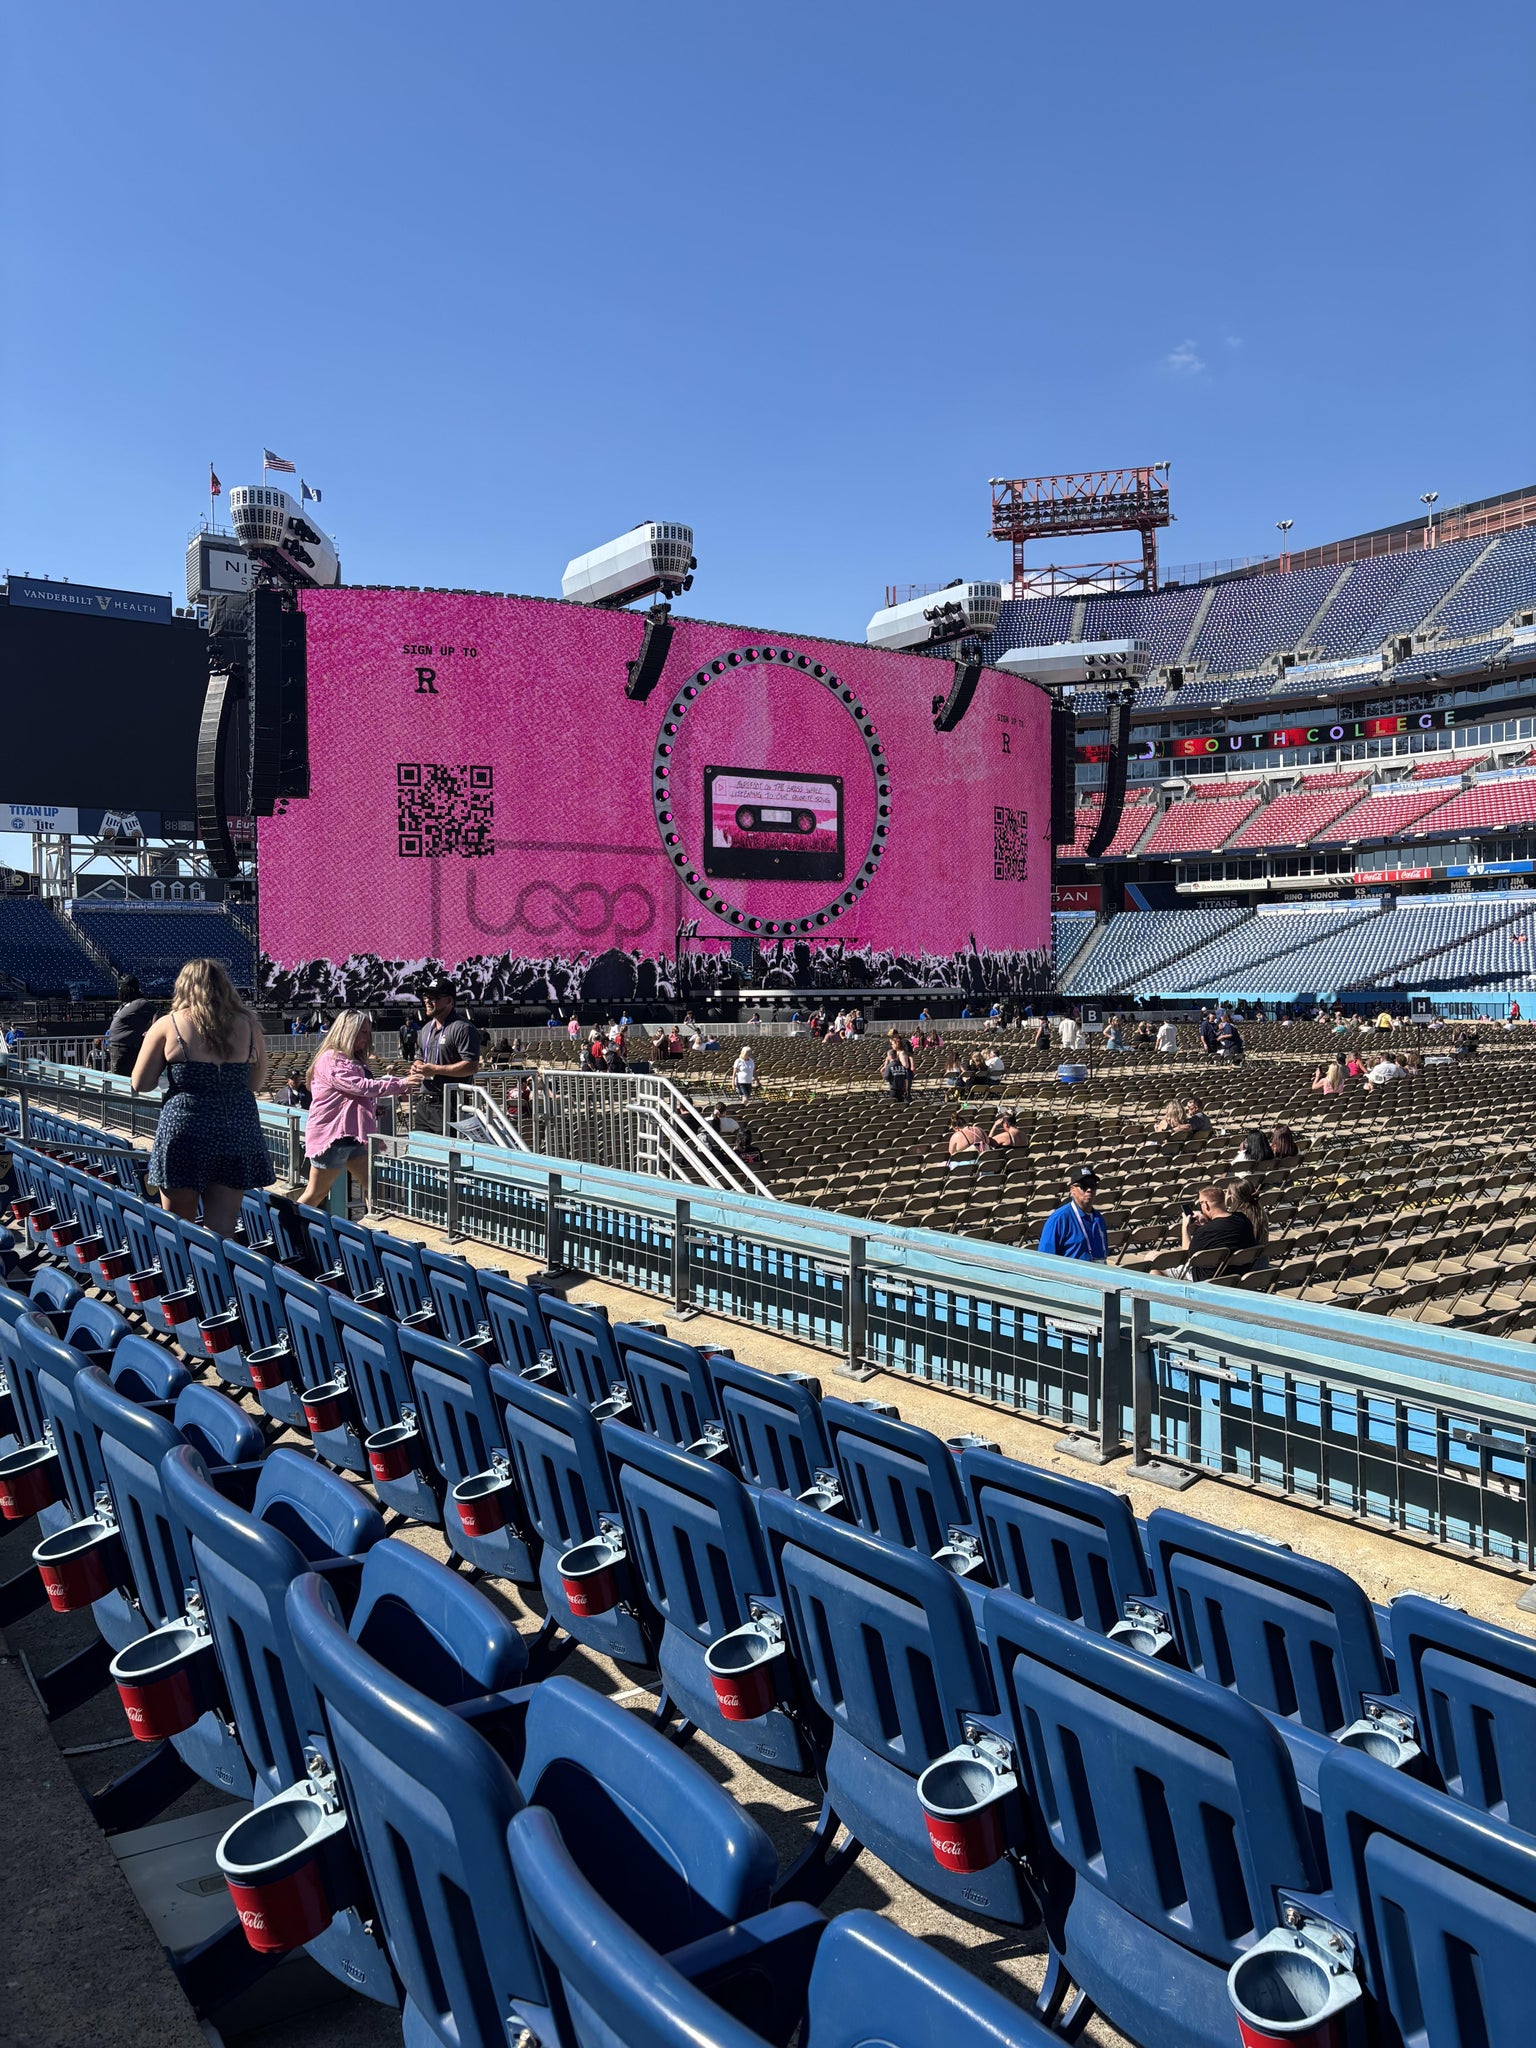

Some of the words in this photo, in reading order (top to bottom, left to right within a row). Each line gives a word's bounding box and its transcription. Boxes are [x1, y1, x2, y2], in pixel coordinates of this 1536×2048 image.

[23, 589, 93, 606] VANDERBILT
[114, 601, 156, 614] HEALTH
[403, 644, 433, 655] SIGN
[440, 646, 455, 656] UP
[462, 647, 477, 658] TO
[414, 667, 439, 694] R
[1184, 732, 1286, 754] SOUTH
[1306, 711, 1455, 742] COLLEGE
[1002, 732, 1011, 754] R
[9, 805, 41, 817] TITAN
[43, 807, 59, 818] UP
[34, 819, 55, 831] Lite
[1362, 873, 1383, 882] Coca-Cola
[1400, 870, 1421, 879] Coca-Cola
[1450, 880, 1471, 889] MIKE
[1510, 877, 1525, 885] JIM
[1284, 893, 1303, 901] RING
[1310, 891, 1340, 900] HONOR
[1354, 887, 1366, 895] KS
[1197, 900, 1238, 909] TITANS
[1417, 1001, 1426, 1013] H
[1088, 1010, 1097, 1021] B
